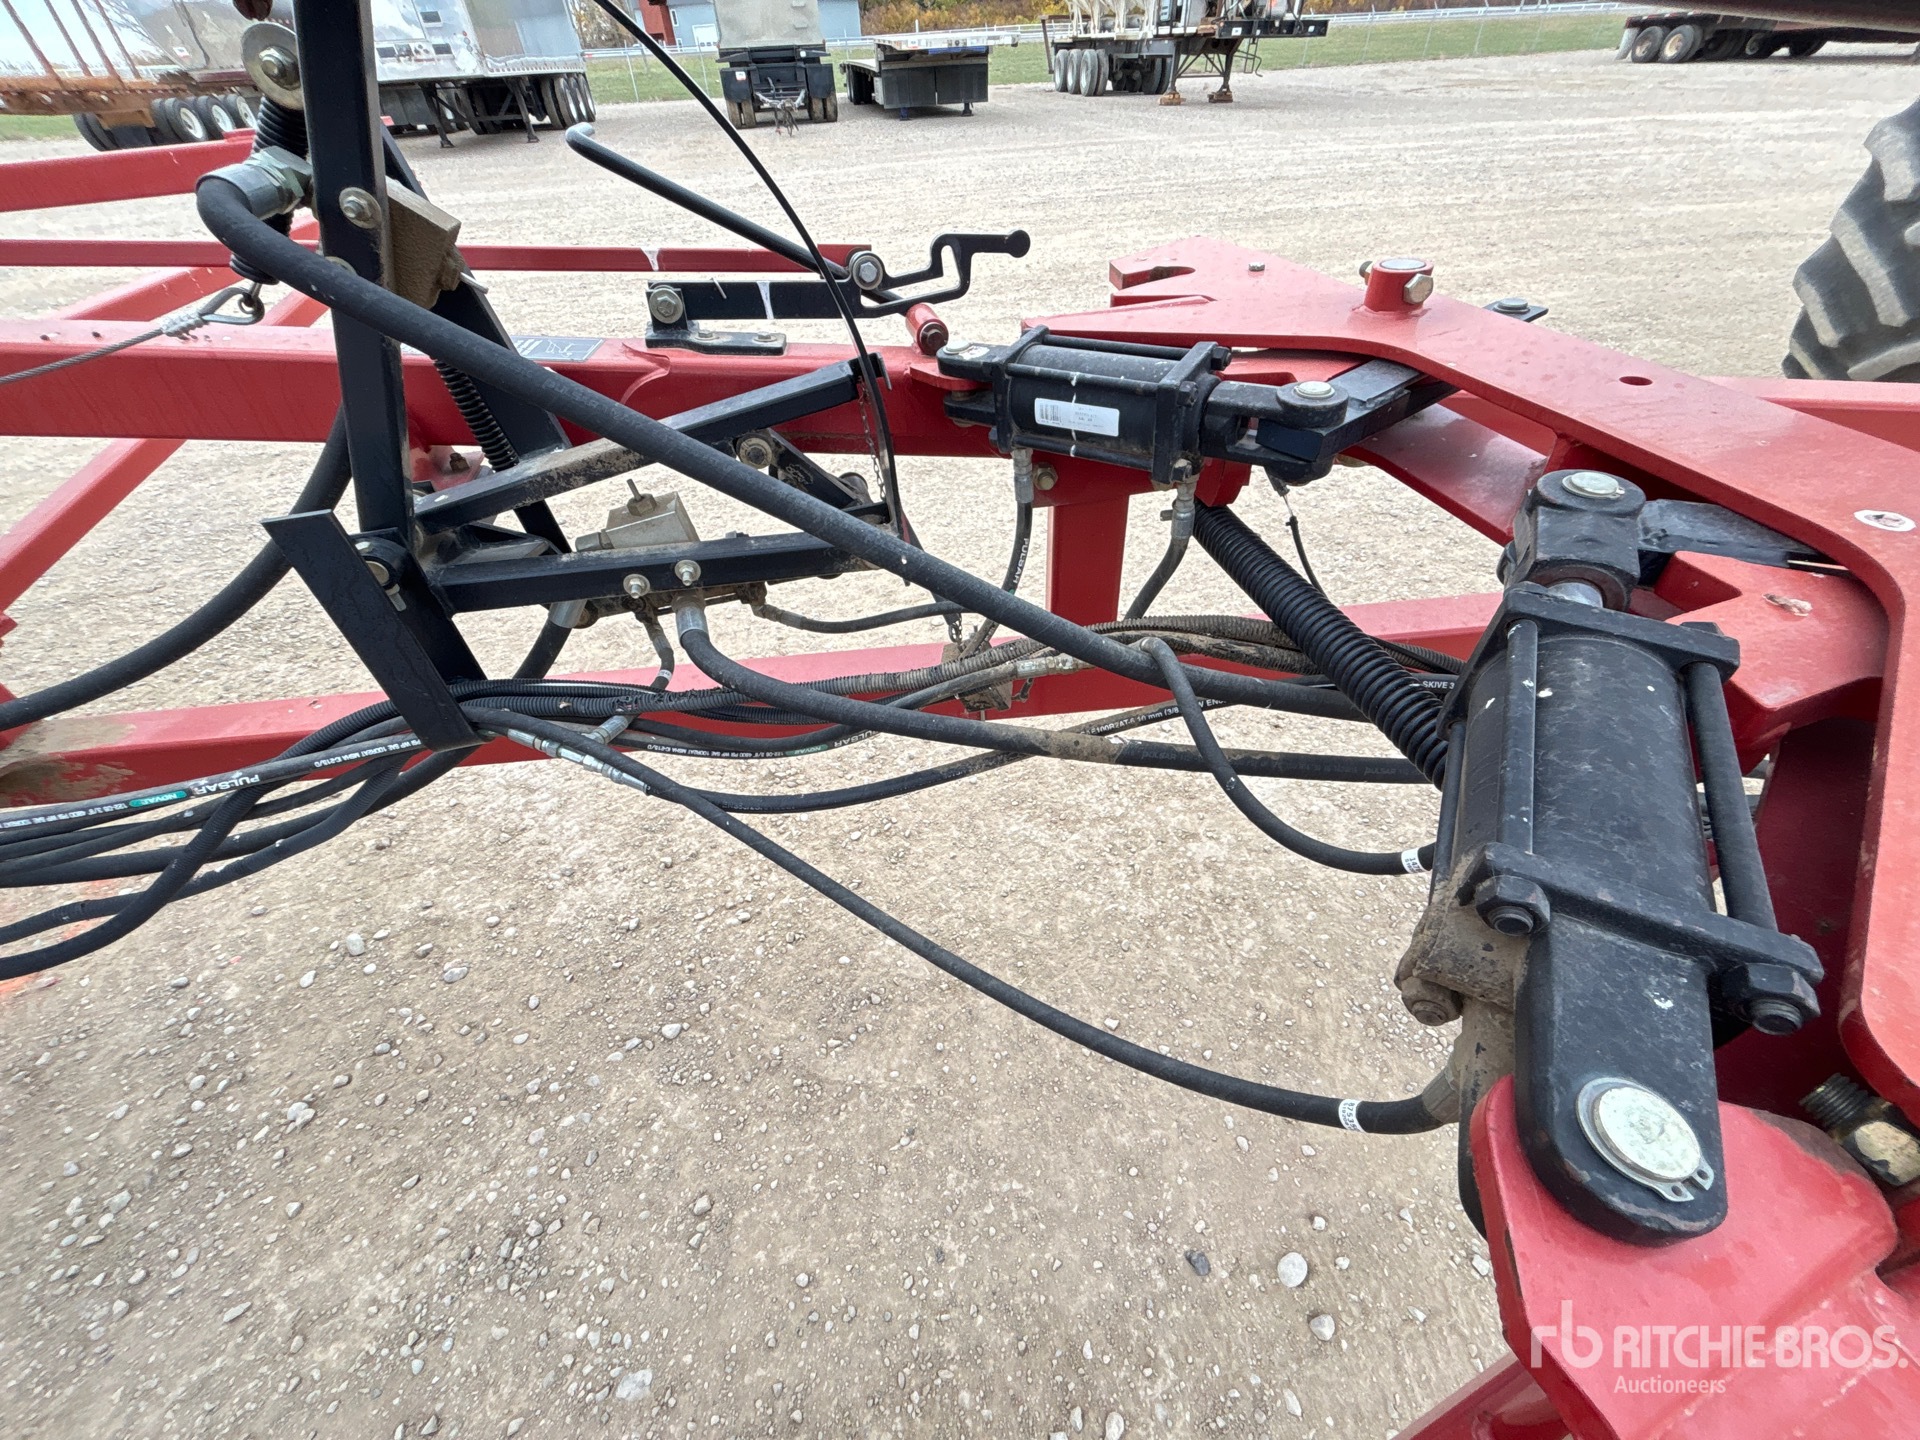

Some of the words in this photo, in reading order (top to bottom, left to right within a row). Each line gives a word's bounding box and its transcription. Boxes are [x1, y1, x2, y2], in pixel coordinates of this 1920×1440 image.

[1422, 680, 1448, 689] SKIVE
[1147, 710, 1163, 720] mm
[193, 773, 260, 795] PULSAR
